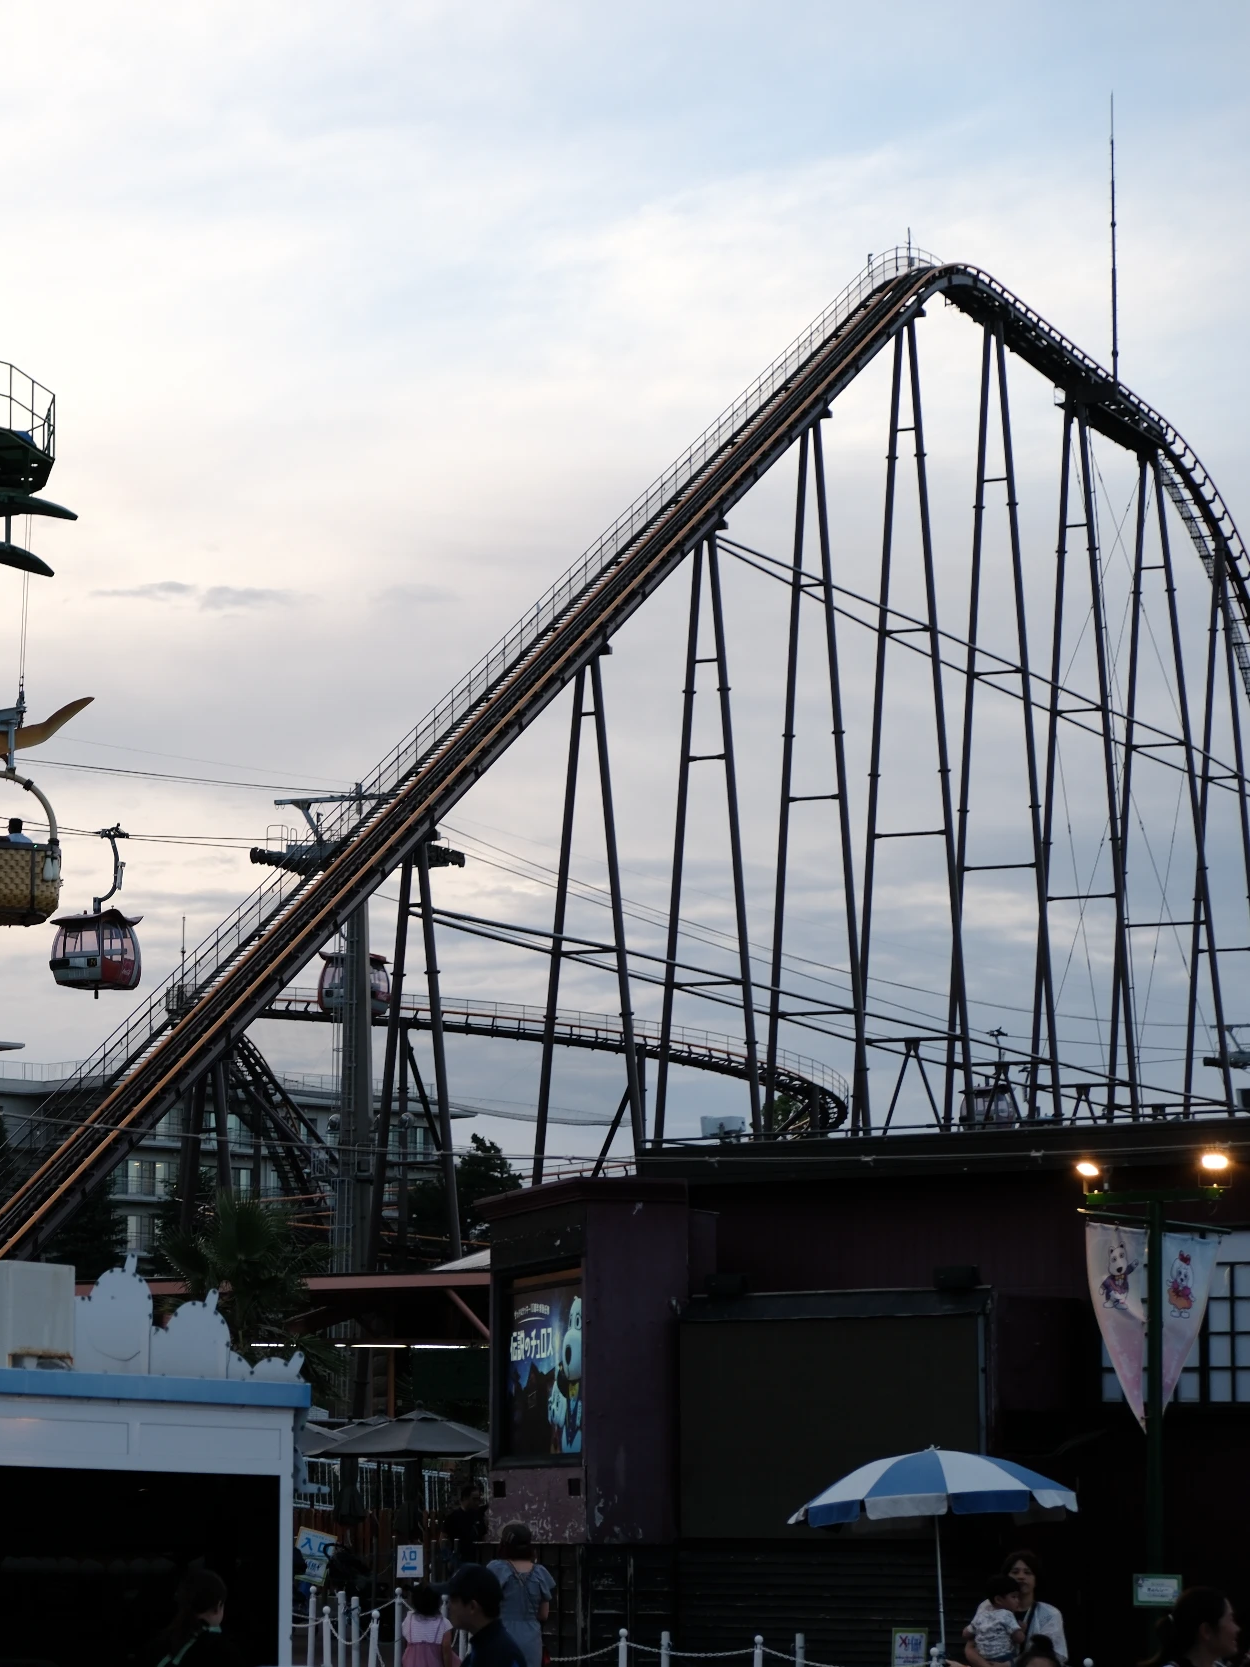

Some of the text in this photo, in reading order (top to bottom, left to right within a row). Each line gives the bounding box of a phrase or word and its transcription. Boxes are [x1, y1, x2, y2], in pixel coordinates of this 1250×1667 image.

[510, 1327, 553, 1361] 伝説のチュロス
[401, 1550, 417, 1561] 入口
